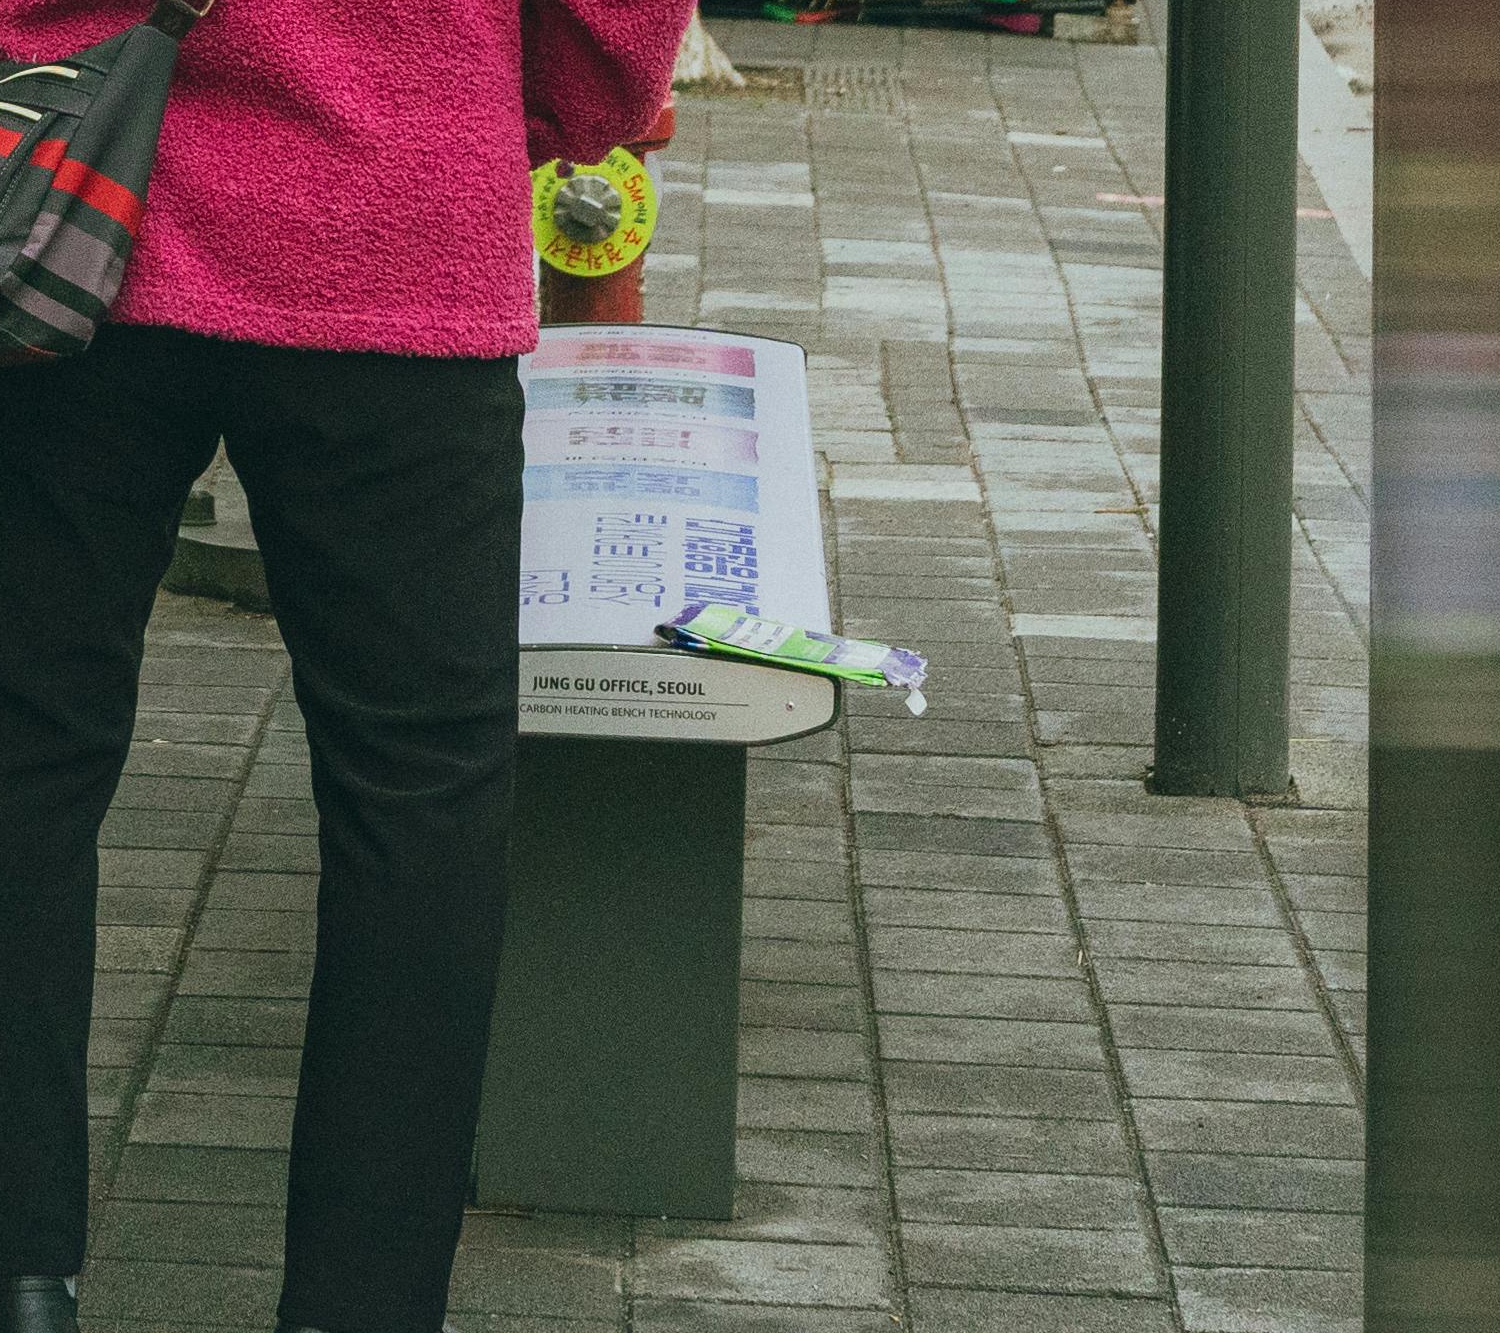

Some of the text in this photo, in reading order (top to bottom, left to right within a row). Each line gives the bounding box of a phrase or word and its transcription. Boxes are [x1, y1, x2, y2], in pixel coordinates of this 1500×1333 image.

[533, 676, 706, 696] JUNG GU OFFICE, SEOUL
[519, 703, 718, 721] CARBON HEATING BENCH TECHNOLOGY
